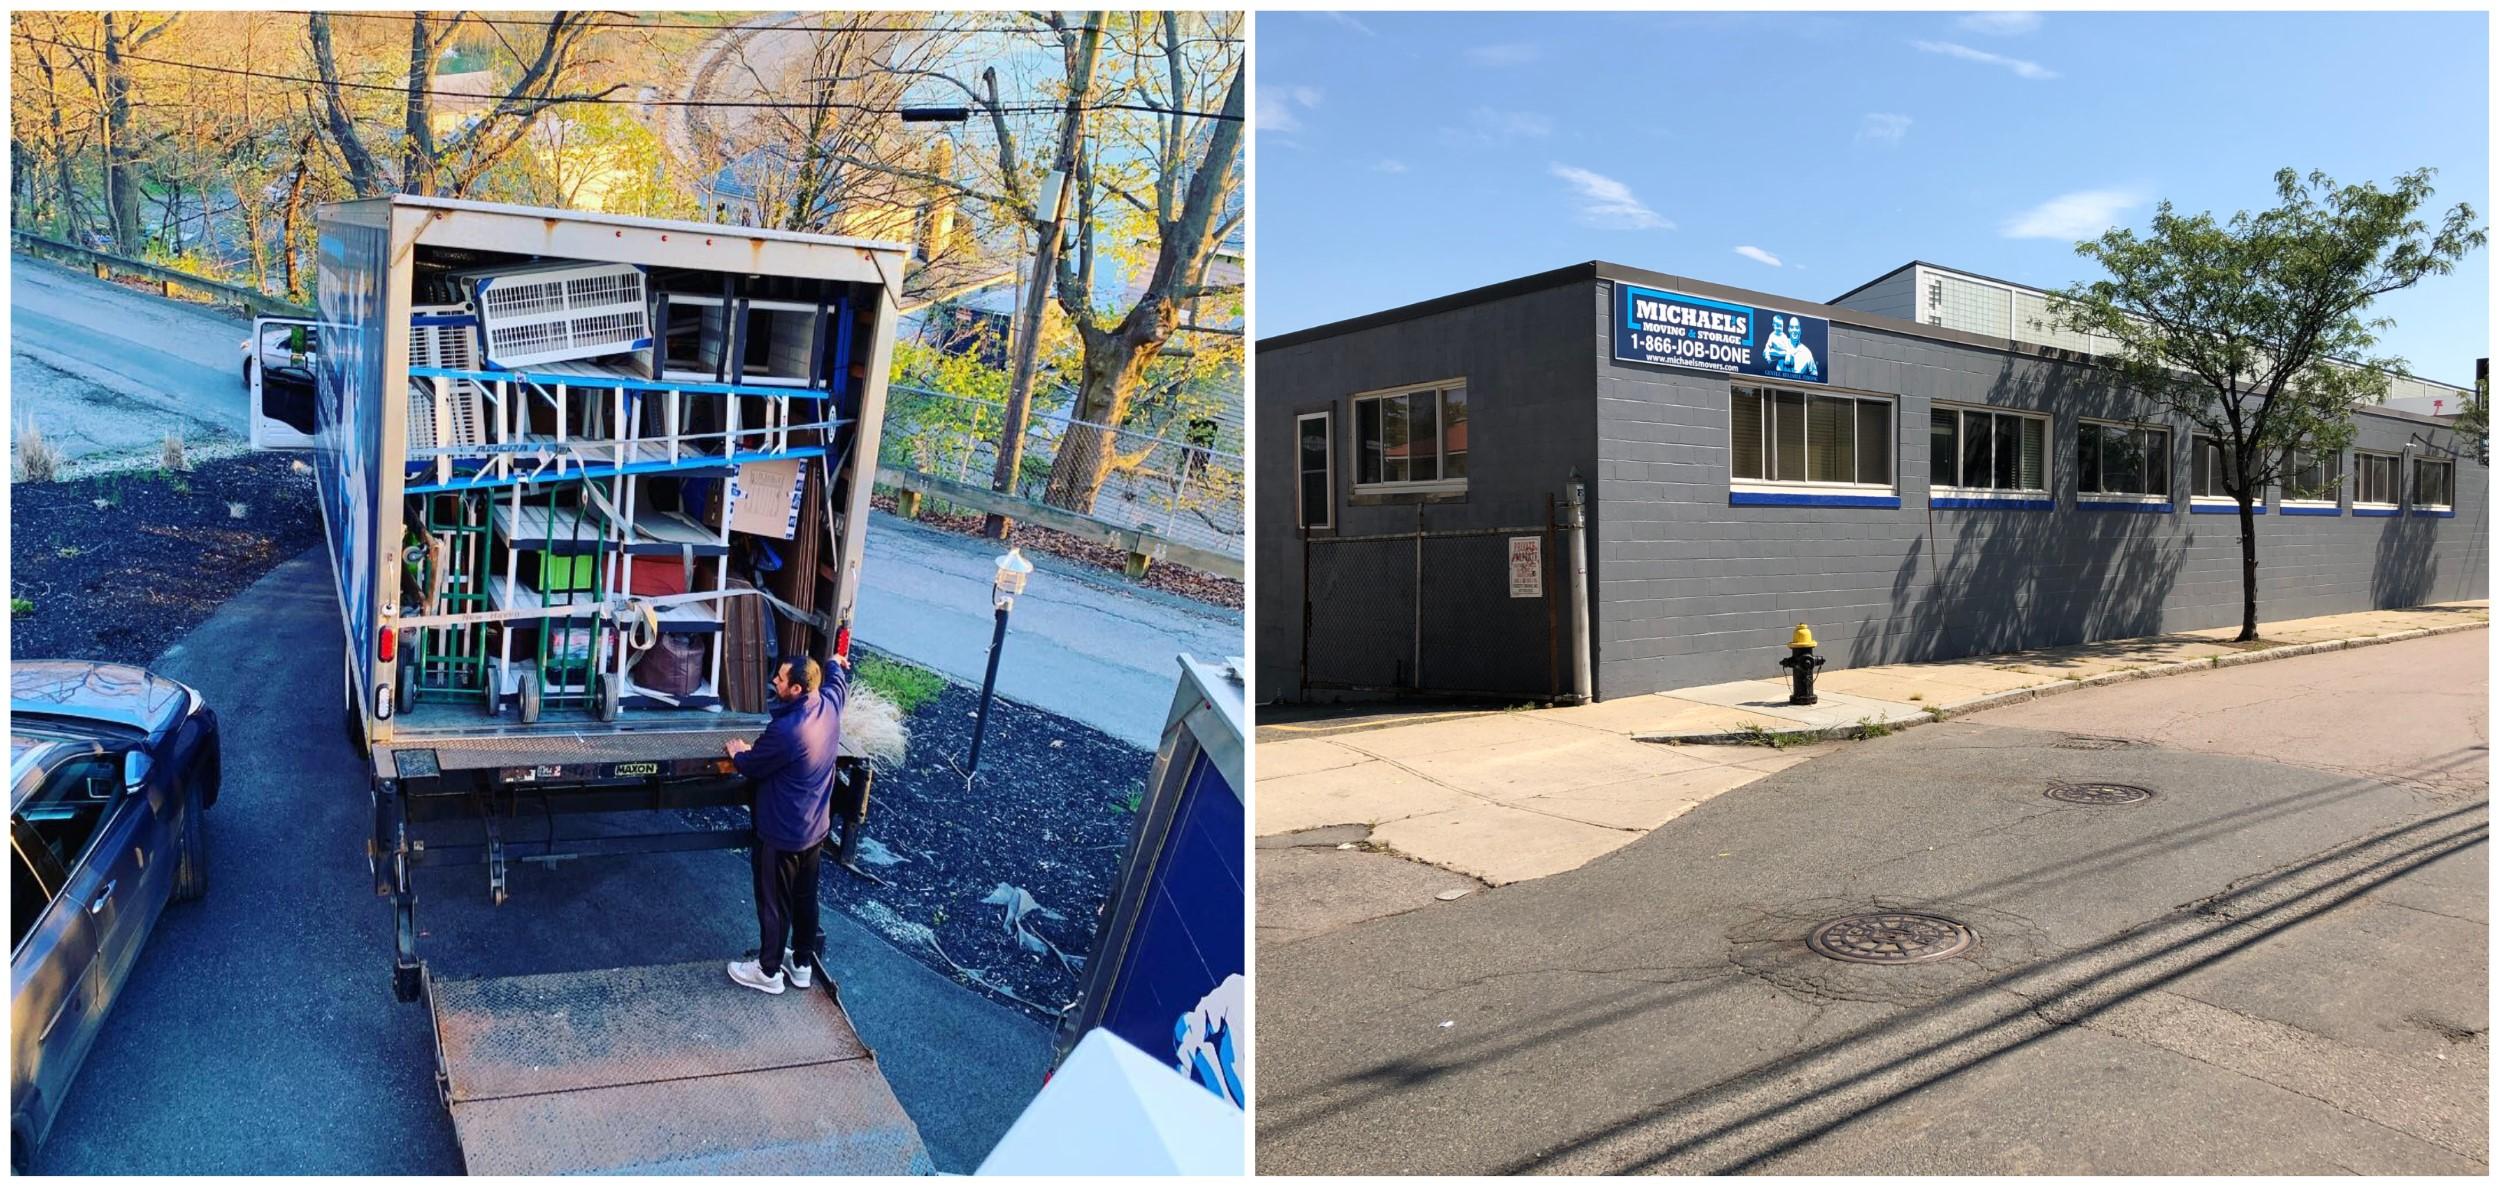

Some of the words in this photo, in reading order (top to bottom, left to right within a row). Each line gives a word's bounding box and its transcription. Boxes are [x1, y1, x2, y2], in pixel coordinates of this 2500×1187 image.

[1636, 299, 1747, 335] MICHAEL'S
[1643, 321, 1686, 337] MOVING
[1687, 328, 1697, 339] &
[1697, 330, 1742, 345] STORAGE
[1631, 333, 1751, 365] 1-866-JOB-DONE
[1646, 354, 1739, 372] www.michaelsmovers.com
[616, 763, 655, 776] MAXON
